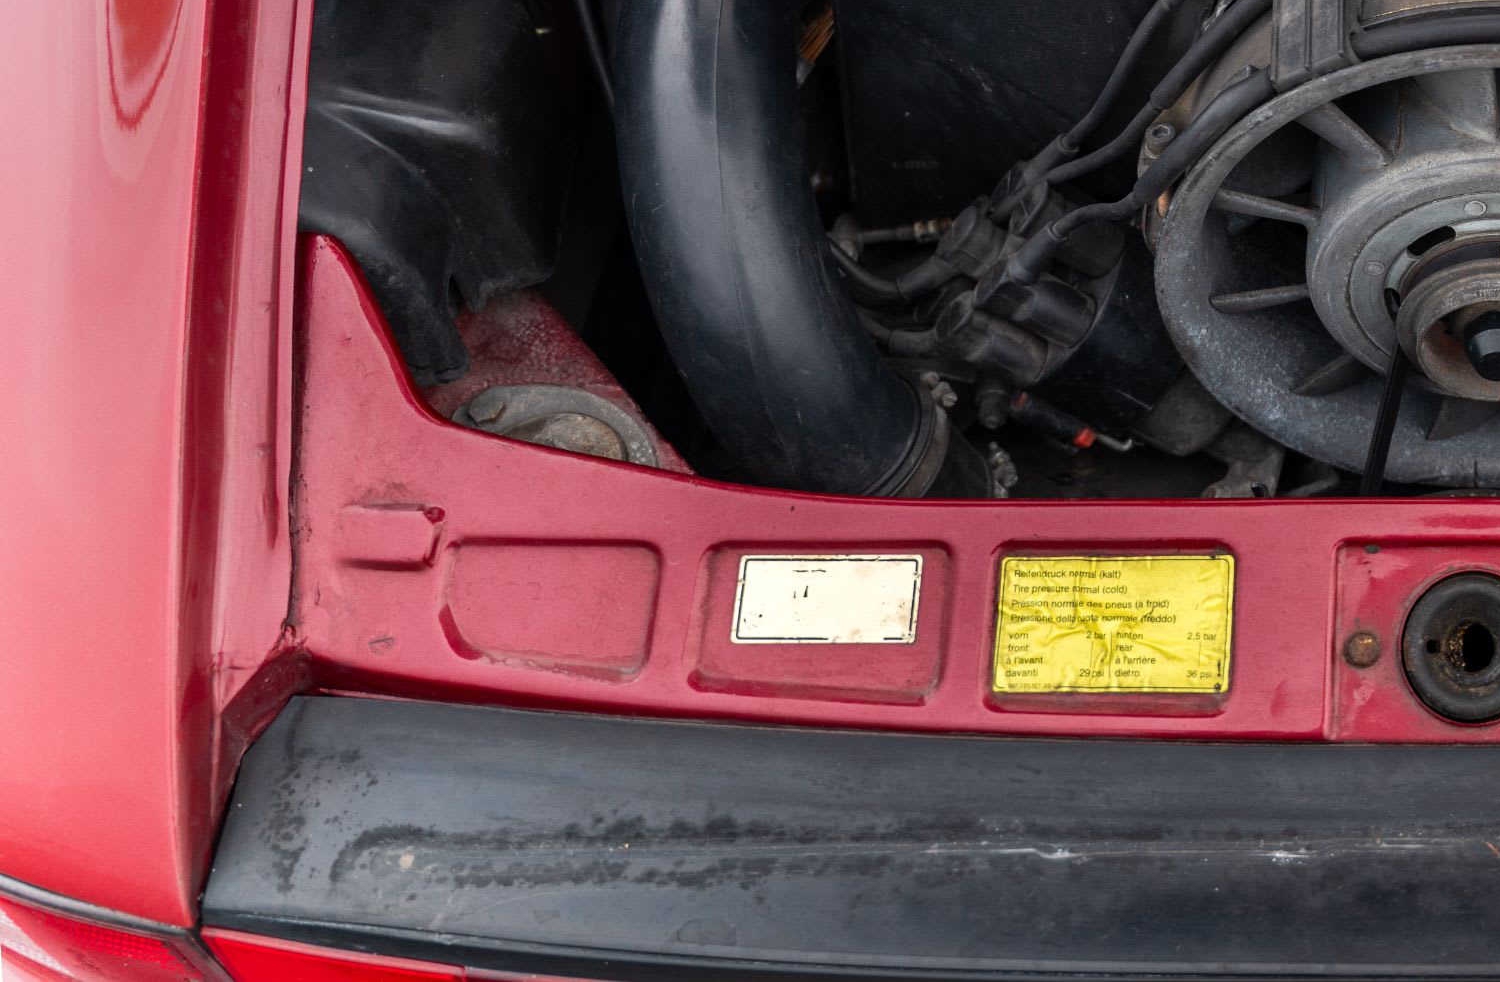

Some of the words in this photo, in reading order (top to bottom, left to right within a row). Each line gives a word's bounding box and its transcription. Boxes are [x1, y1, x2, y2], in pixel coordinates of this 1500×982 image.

[1014, 569, 1066, 578] Reifendruck
[1100, 570, 1121, 579] (kalt)
[1032, 586, 1069, 594] pressure
[1102, 585, 1128, 594] (cold)
[1011, 599, 1048, 608] Pression
[1011, 614, 1053, 623] Pressione
[1094, 631, 1106, 639] bar
[1116, 631, 1144, 639] hinten
[1203, 632, 1216, 640] bar
[1008, 644, 1029, 652] front
[1116, 644, 1133, 652] rear
[1014, 656, 1043, 664] l'avant
[1005, 669, 1038, 677] davanti
[1079, 668, 1090, 677] 29
[1092, 669, 1105, 678] psi
[1115, 669, 1140, 677] dietro
[1200, 670, 1212, 678] psi
